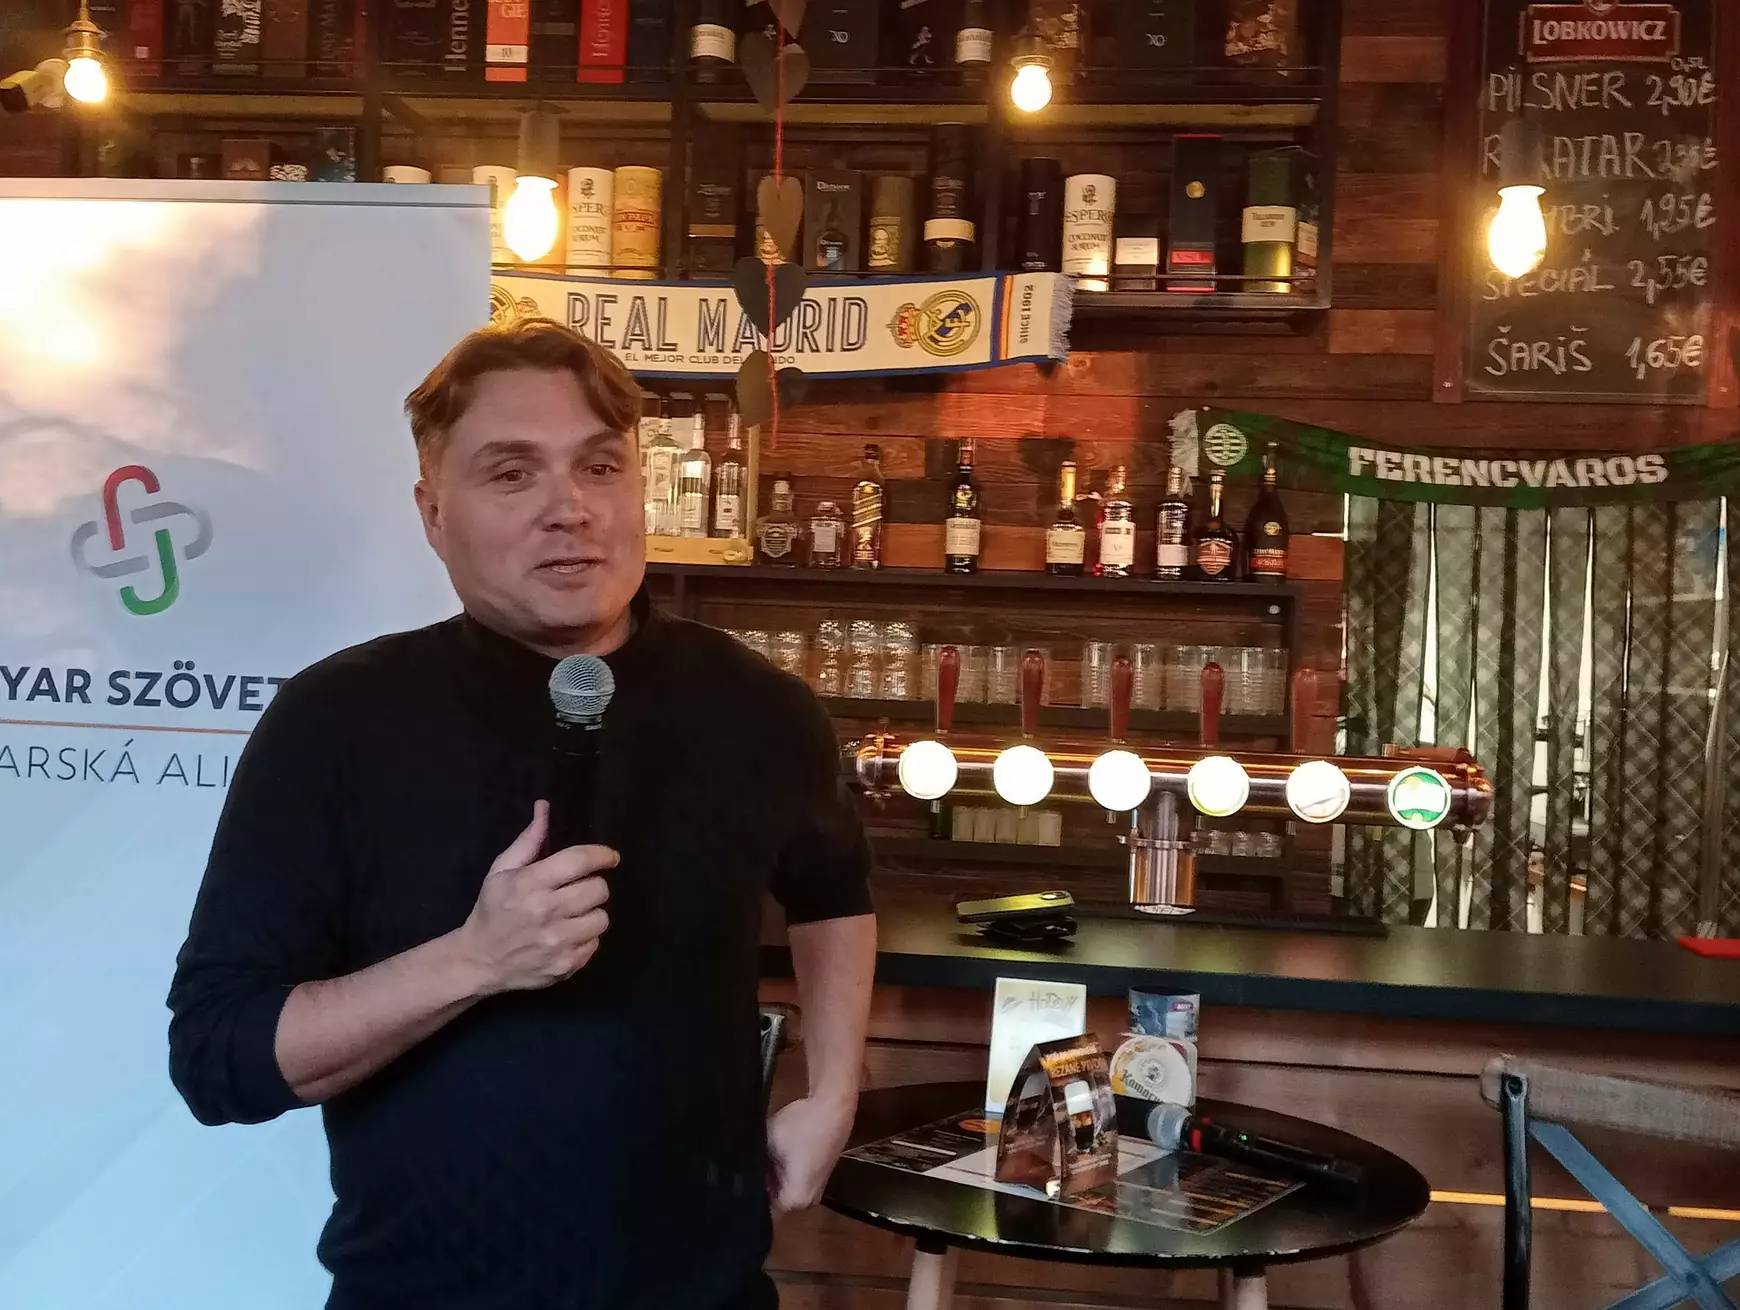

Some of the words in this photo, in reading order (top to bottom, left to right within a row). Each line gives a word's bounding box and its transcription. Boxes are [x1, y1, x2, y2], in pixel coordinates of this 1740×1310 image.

[1532, 19, 1668, 45] LOBKOWICZ
[566, 292, 678, 351] REAL
[1019, 314, 1031, 344] SINCE
[625, 352, 639, 361] EL
[644, 353, 685, 363] MEJOR
[689, 355, 720, 364] CLUB
[156, 753, 228, 787] ALI
